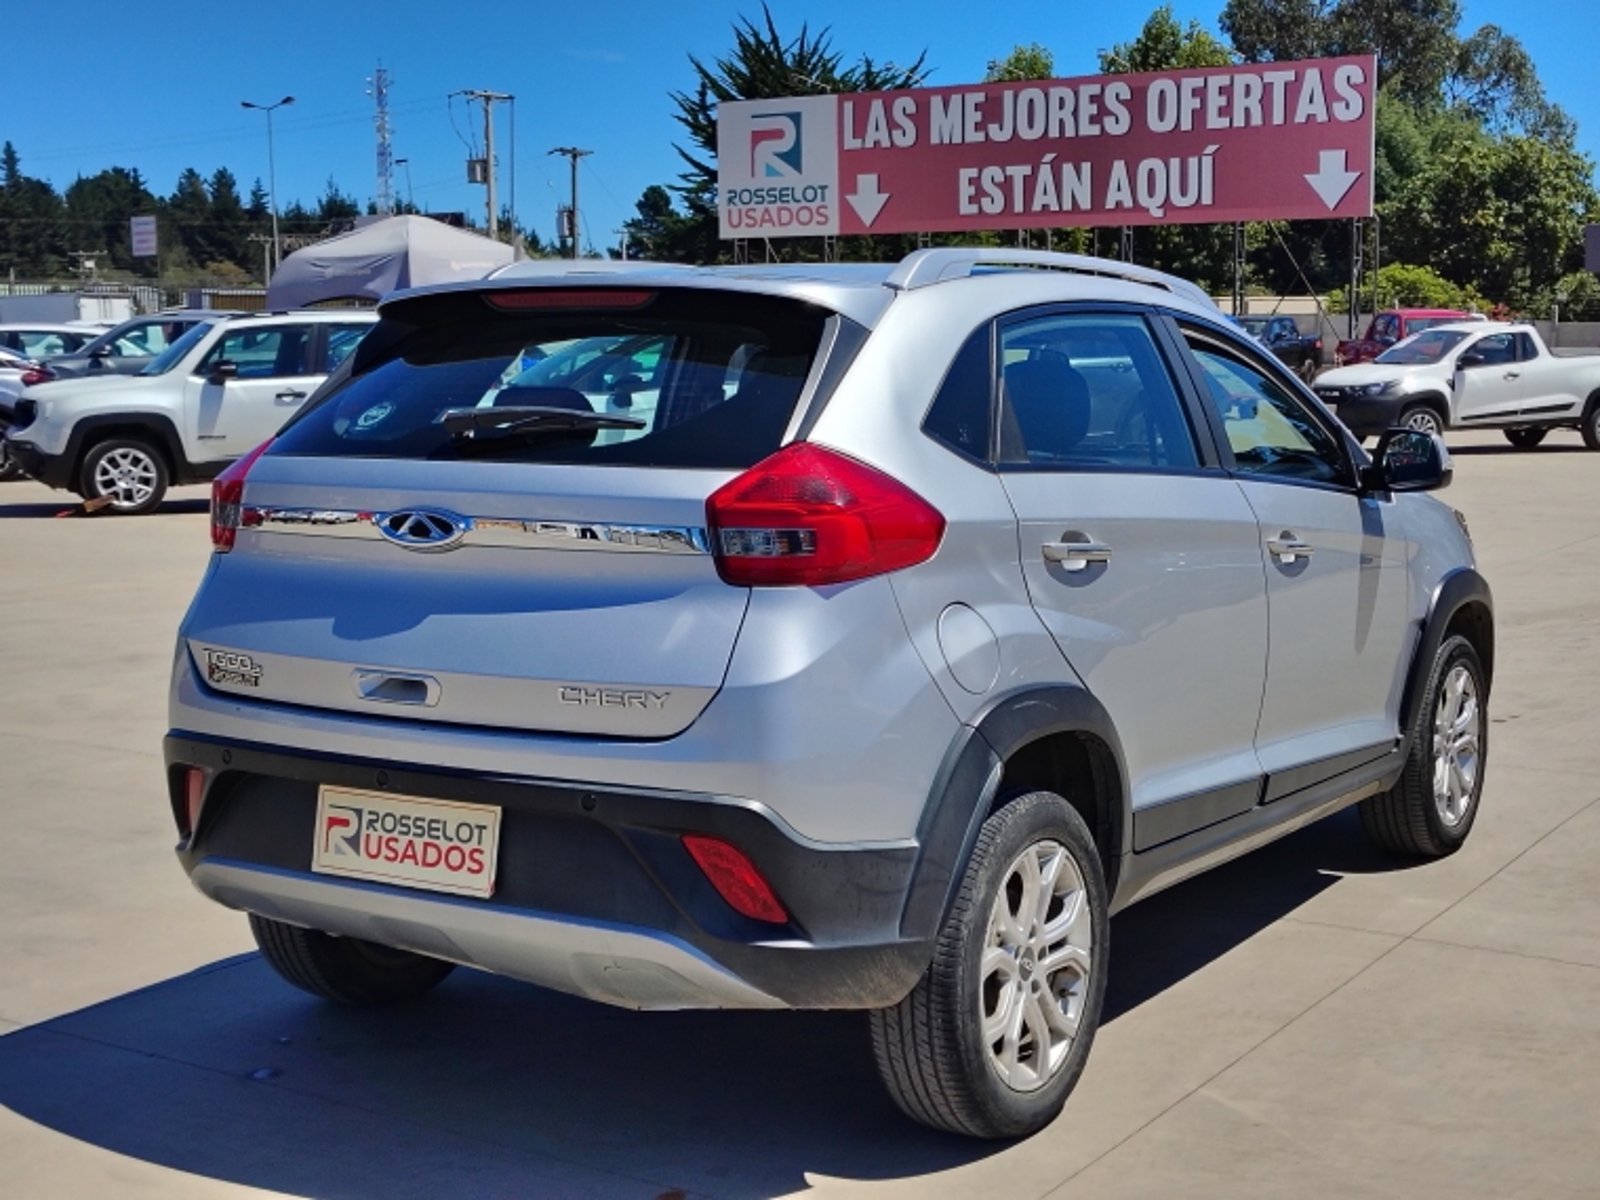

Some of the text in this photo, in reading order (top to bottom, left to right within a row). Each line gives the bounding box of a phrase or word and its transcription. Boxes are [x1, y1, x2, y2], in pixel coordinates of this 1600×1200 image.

[843, 64, 1366, 150] LAS MEJORES OFERTAS
[727, 185, 829, 206] ROSSELOT
[959, 144, 1221, 218] ESTÁN AQUÍ
[727, 205, 830, 229] USADOS
[558, 686, 671, 708] CHERY
[365, 810, 487, 845] ROSSELOT
[364, 833, 485, 875] USADOS
